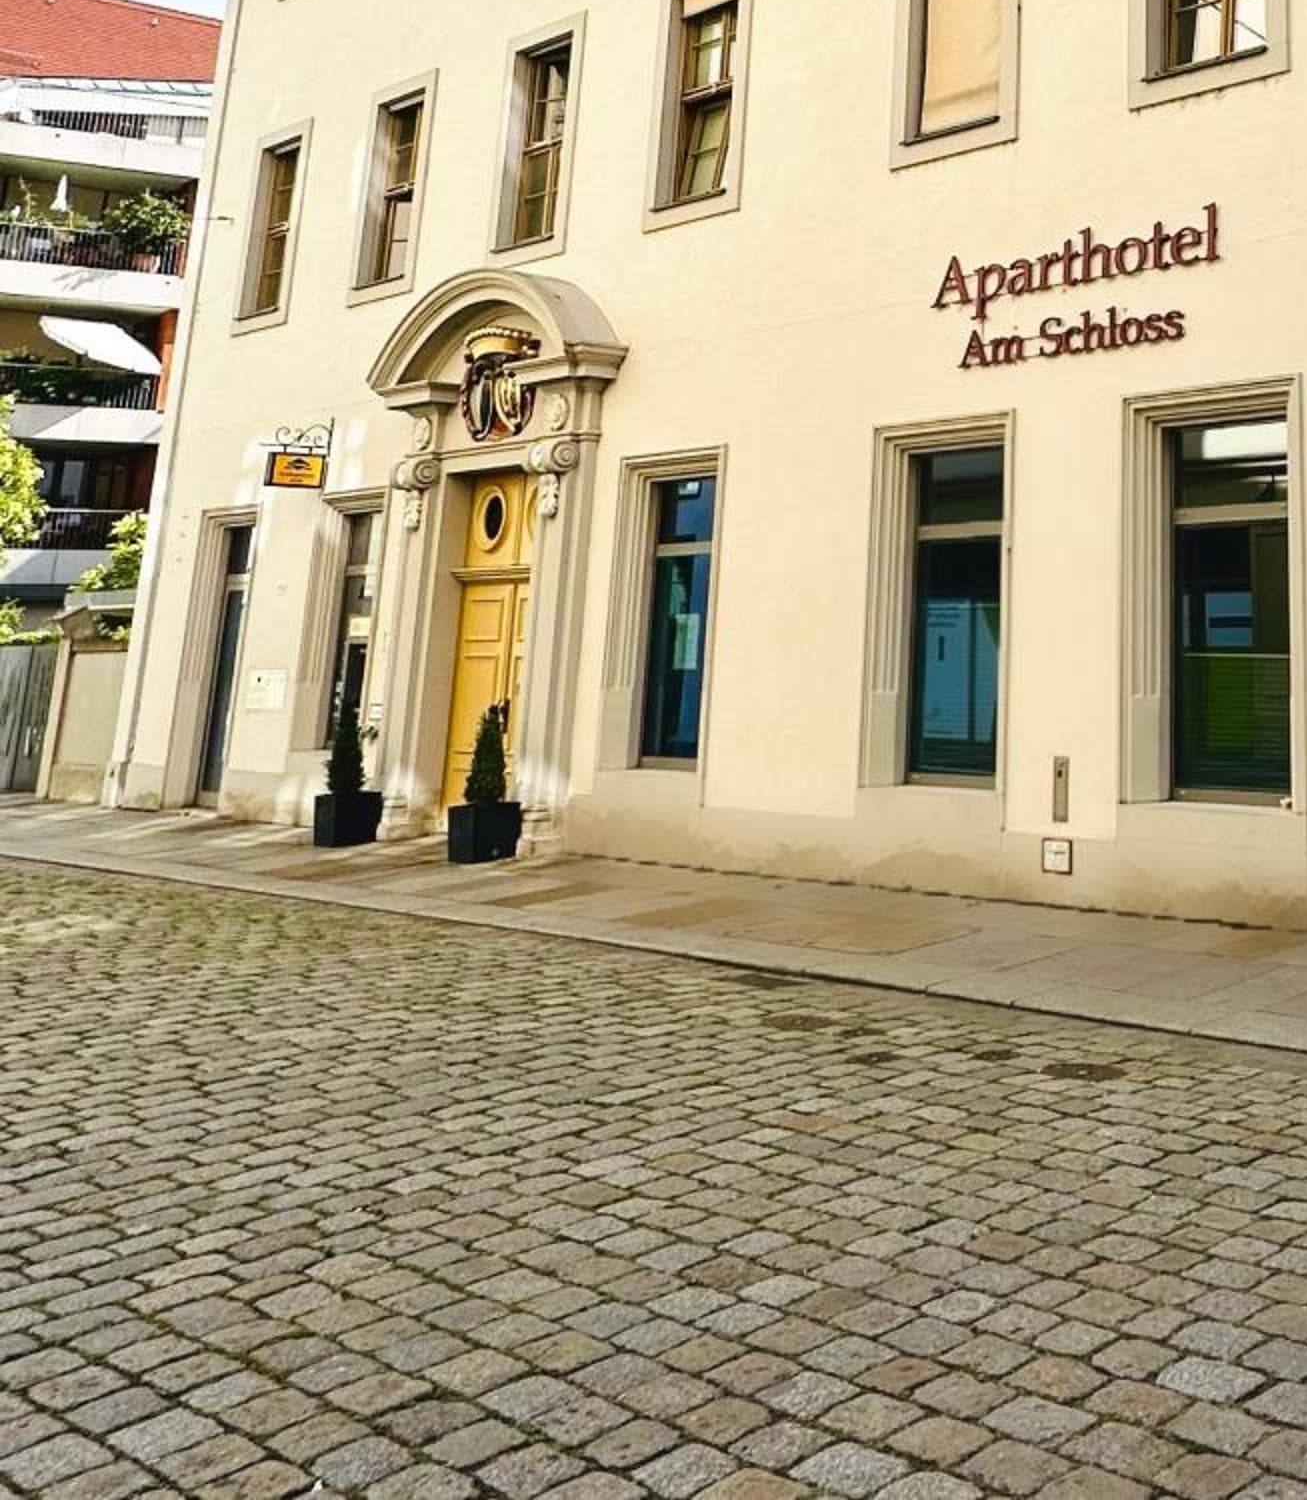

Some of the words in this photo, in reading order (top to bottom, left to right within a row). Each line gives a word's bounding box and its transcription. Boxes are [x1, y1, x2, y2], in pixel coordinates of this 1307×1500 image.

[930, 201, 1220, 321] Aparthotel
[957, 329, 1026, 369] Am
[1038, 306, 1186, 357] Schloss
